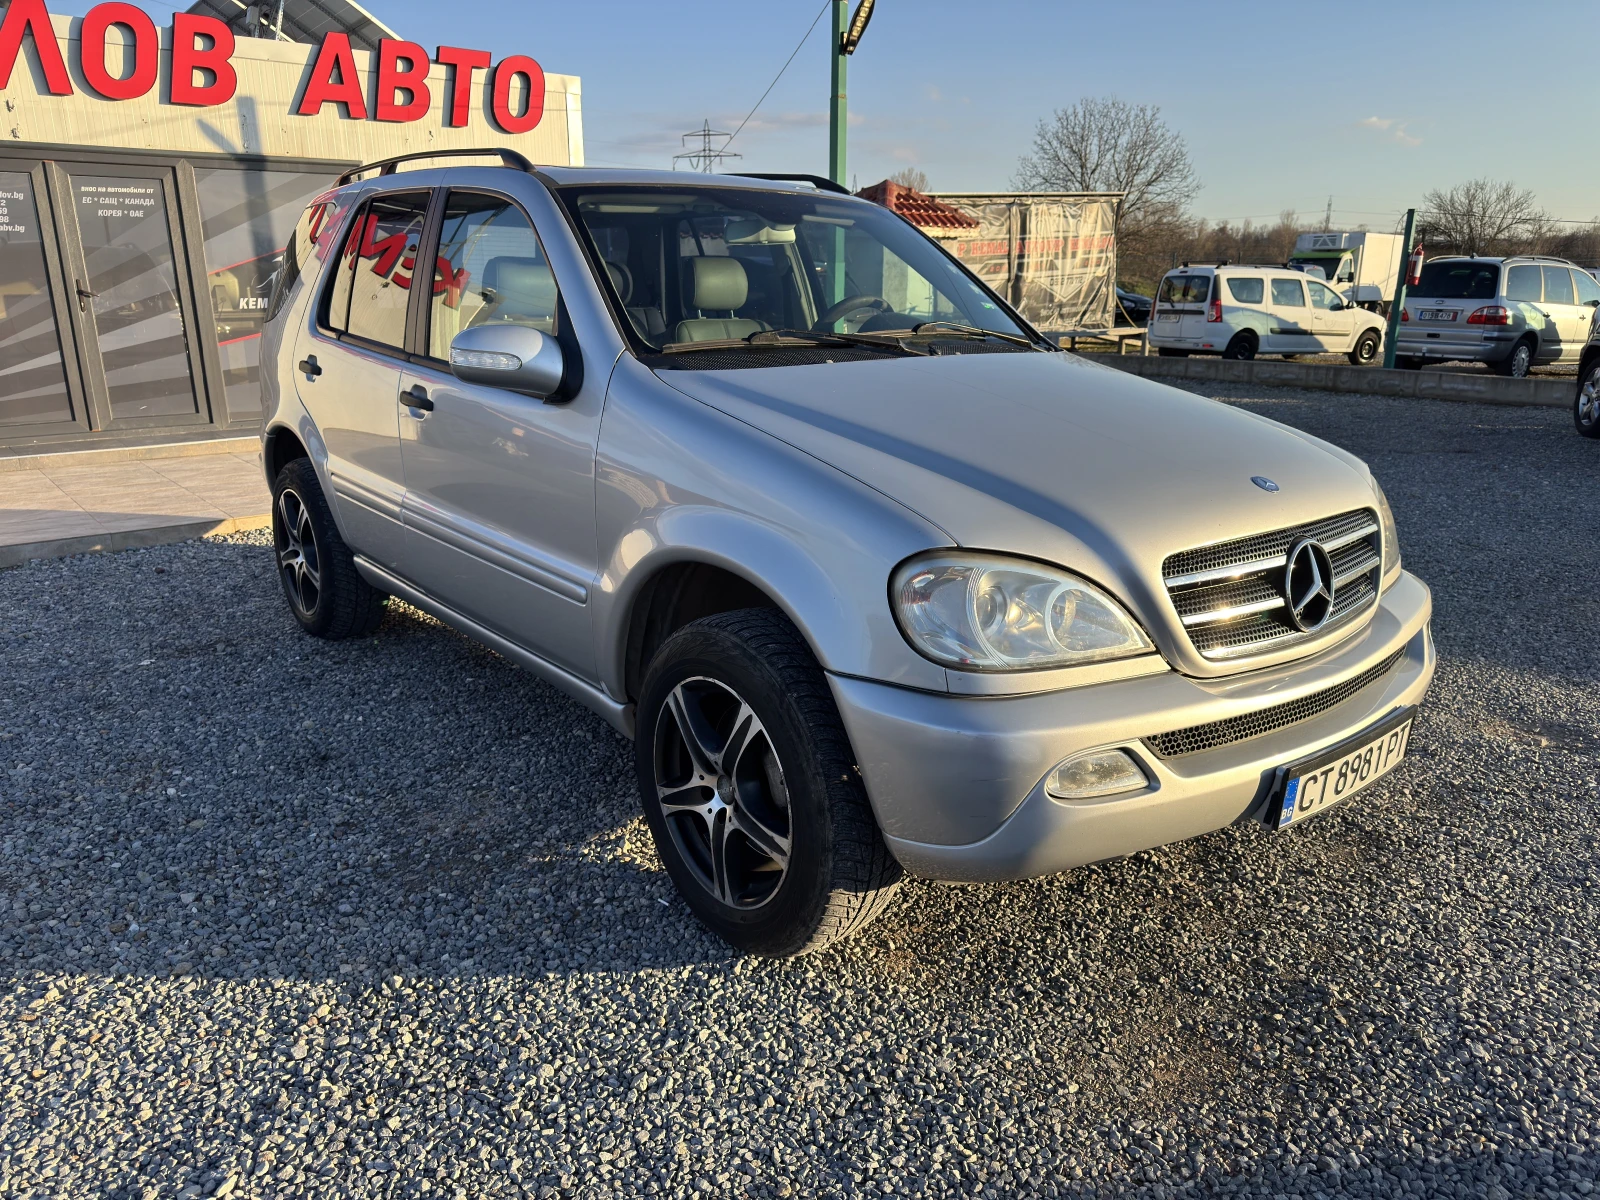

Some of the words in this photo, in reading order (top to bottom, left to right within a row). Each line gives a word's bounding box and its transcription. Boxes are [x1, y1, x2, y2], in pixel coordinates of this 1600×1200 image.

[0, 0, 237, 106] ЛОВ
[298, 32, 545, 134] АВТО
[82, 196, 92, 204] ЕС
[100, 197, 118, 205] САЩ
[125, 198, 155, 206] КАНАДА
[98, 209, 122, 217] КОРЕЯ
[1281, 806, 1293, 820] BG
